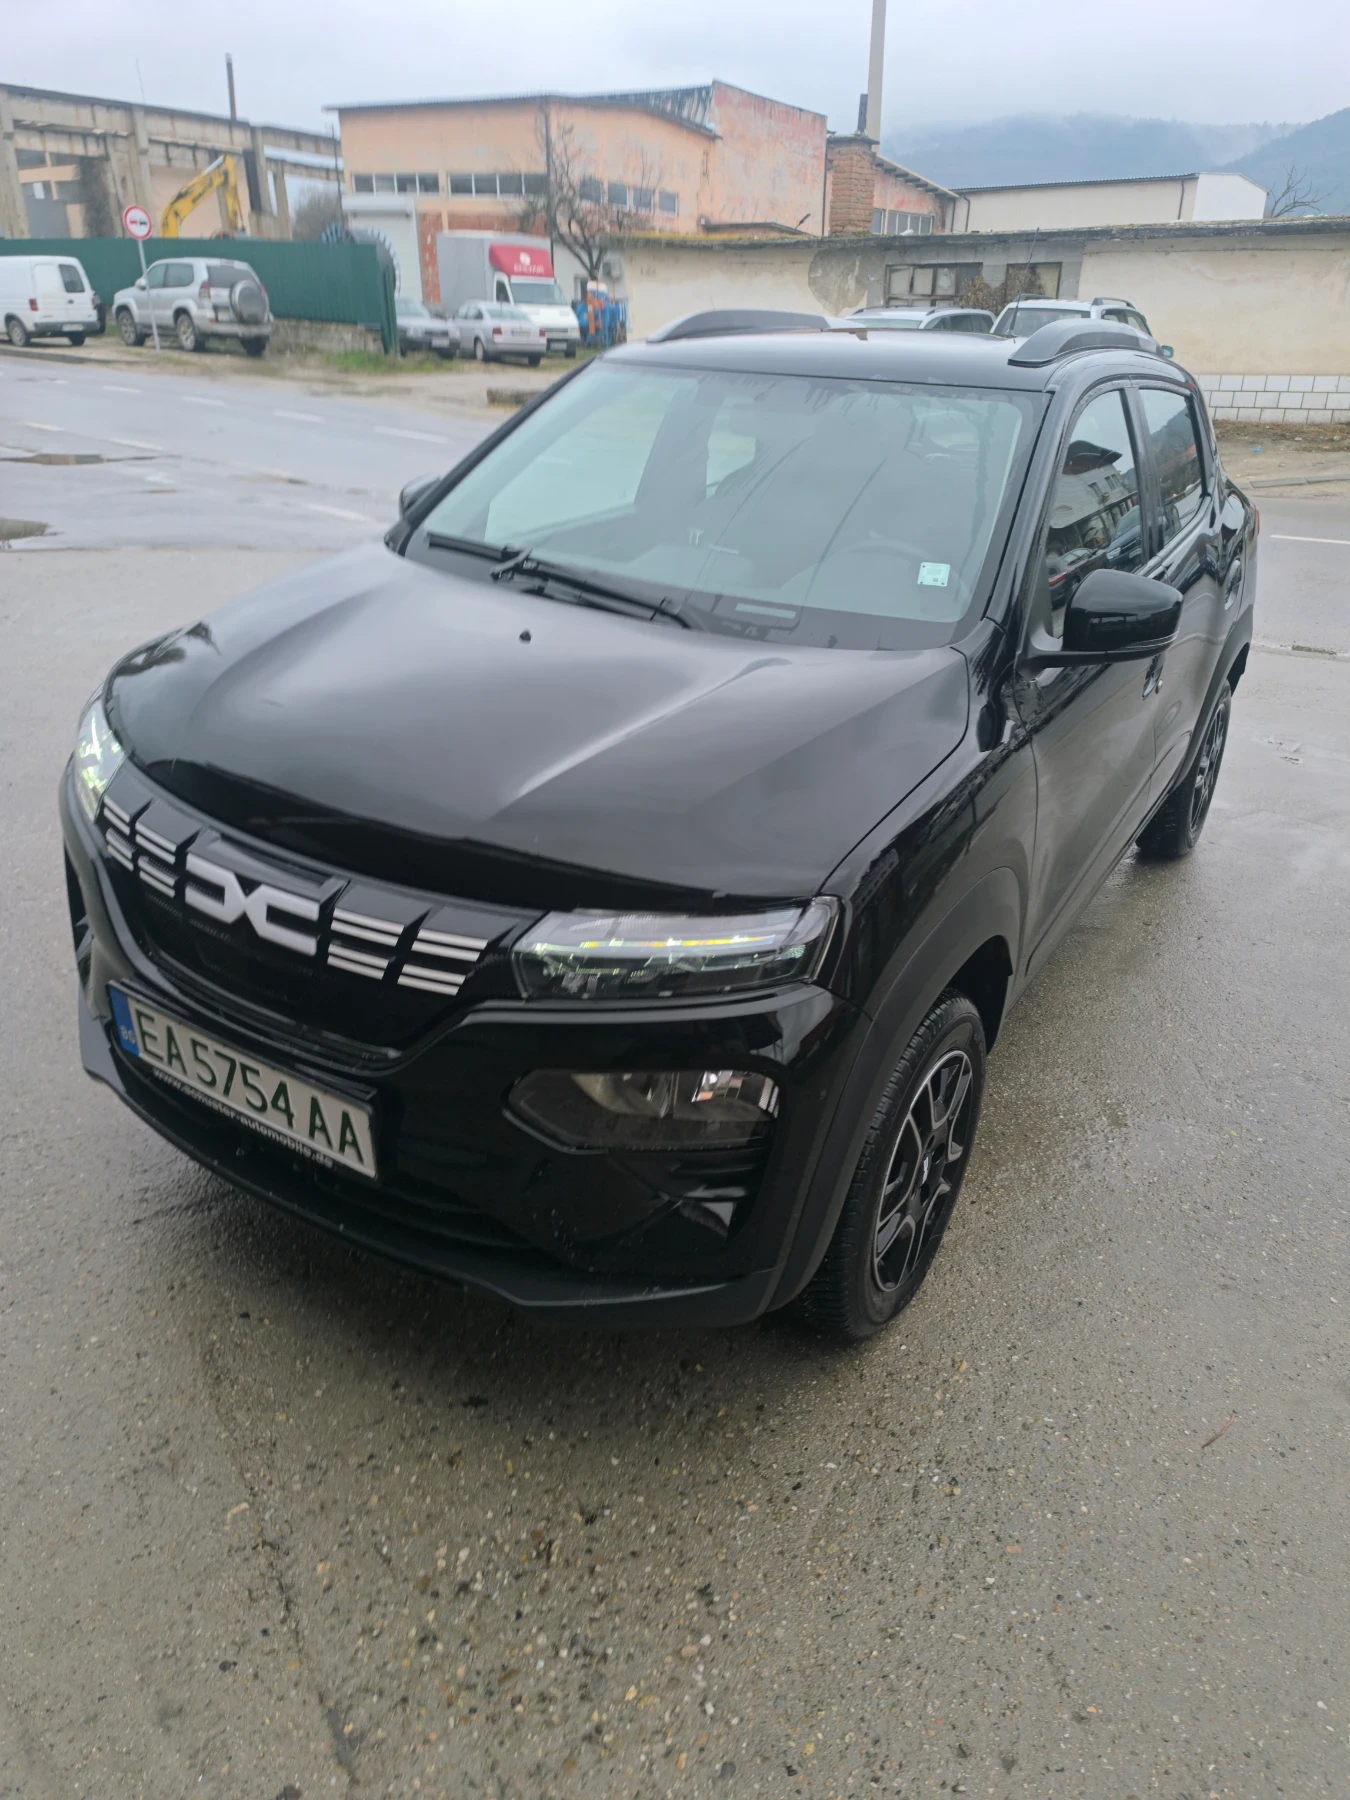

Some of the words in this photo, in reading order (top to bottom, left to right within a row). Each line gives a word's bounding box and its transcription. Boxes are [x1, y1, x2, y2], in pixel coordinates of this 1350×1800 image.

[135, 1009, 188, 1075] EA
[190, 1037, 295, 1128] 5754
[308, 1094, 365, 1164] AA
